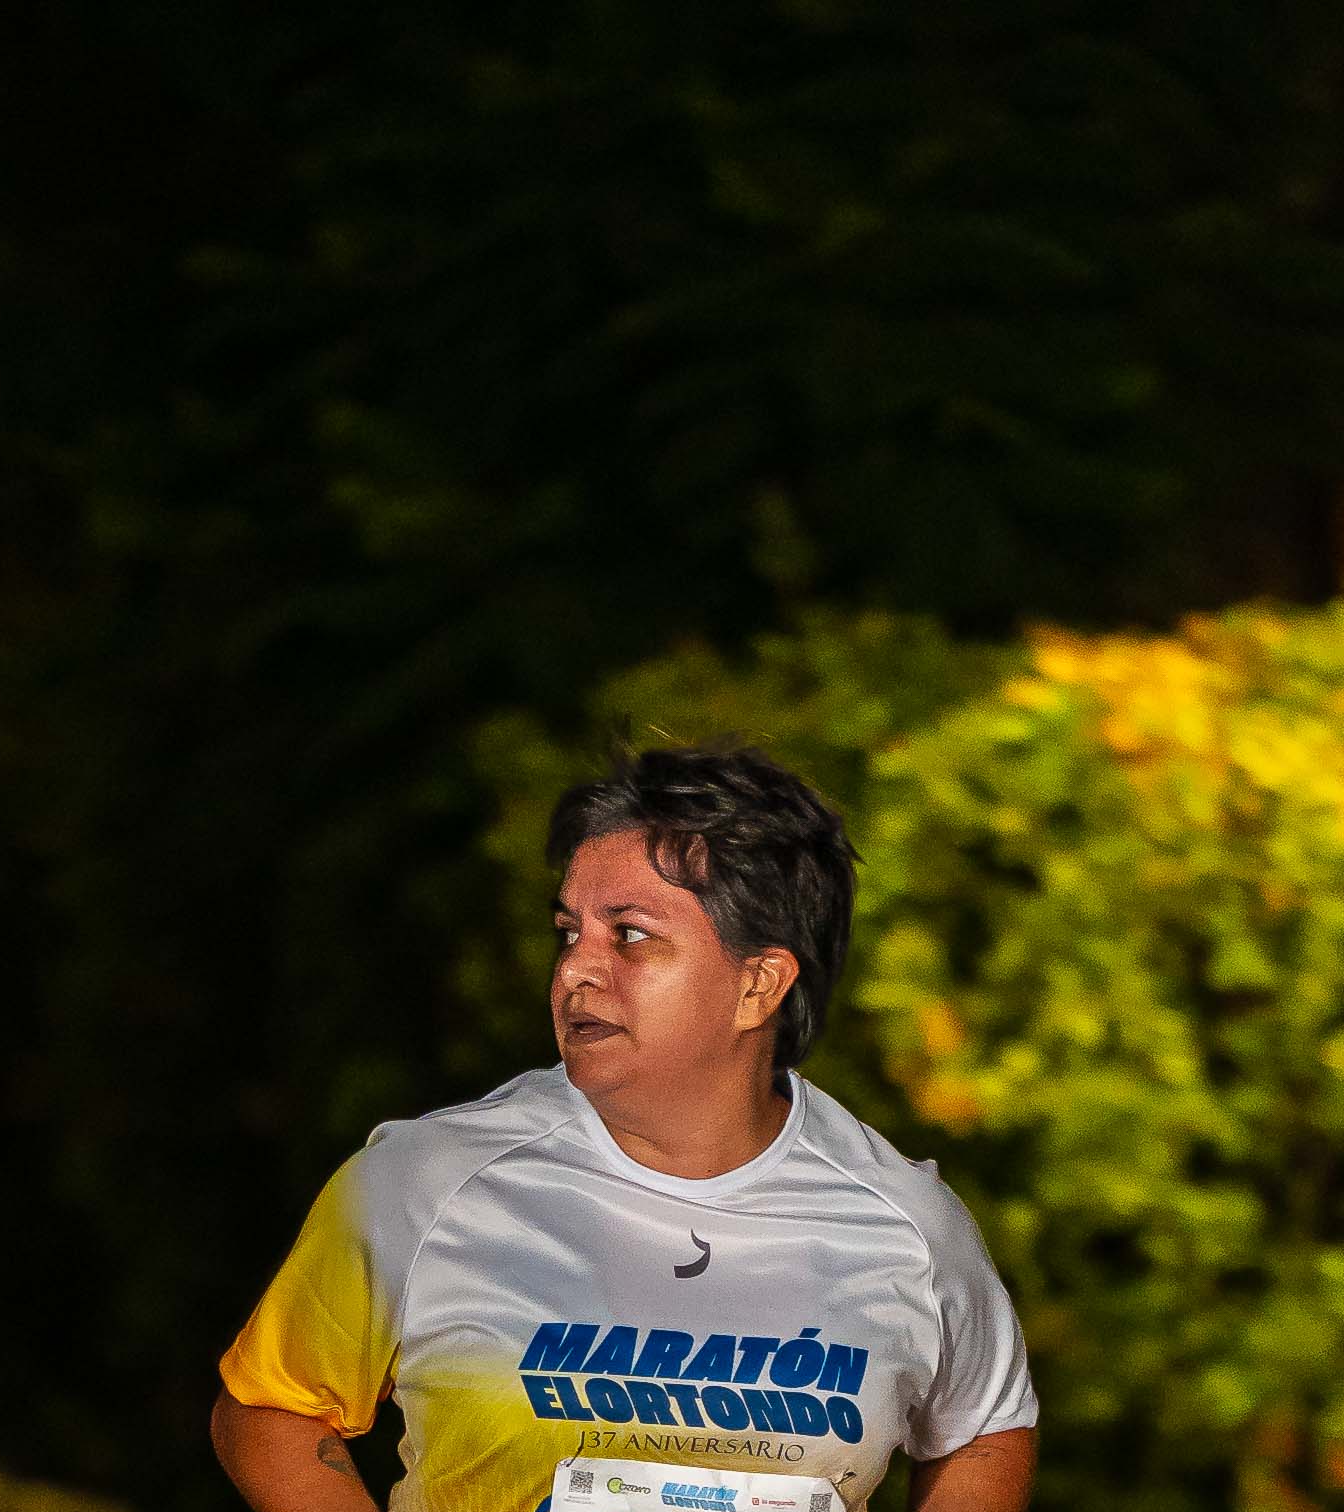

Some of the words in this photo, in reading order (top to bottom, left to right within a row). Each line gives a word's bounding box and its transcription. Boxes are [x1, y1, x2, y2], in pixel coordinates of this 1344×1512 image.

[517, 1321, 870, 1396] MARATÓN
[519, 1373, 864, 1446] ELORTONDO
[624, 1433, 805, 1463] ANIVERSARIO
